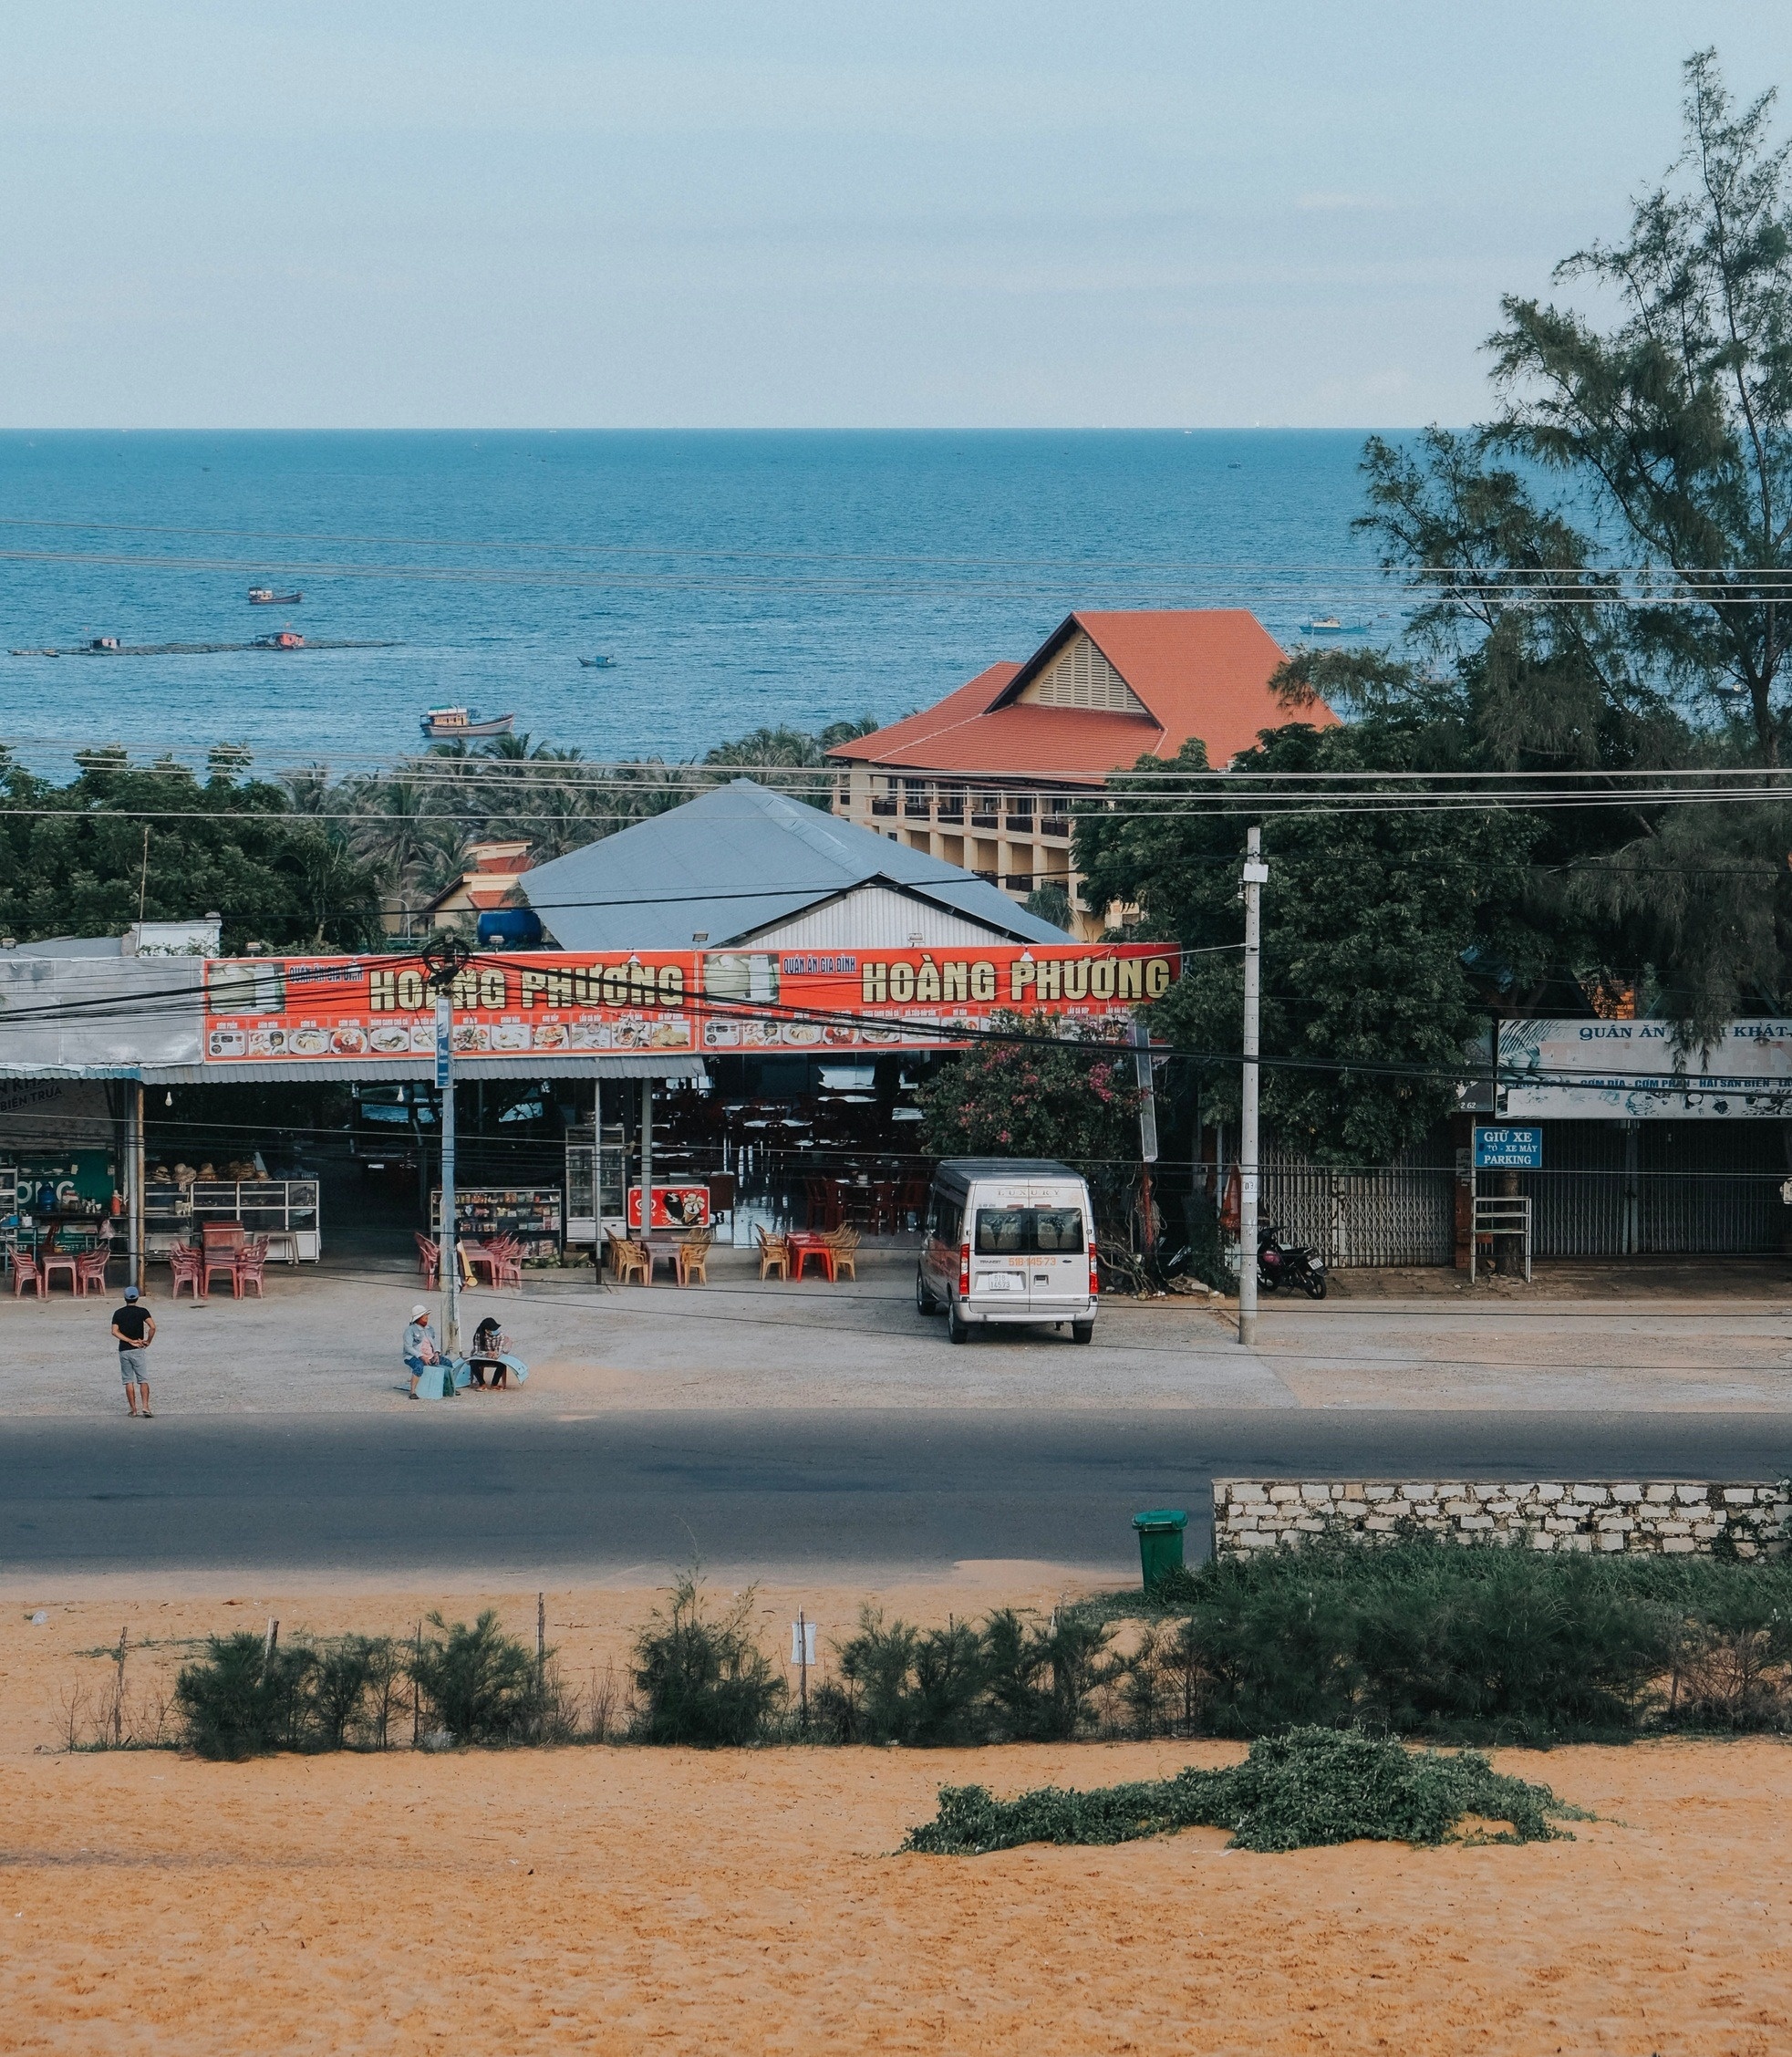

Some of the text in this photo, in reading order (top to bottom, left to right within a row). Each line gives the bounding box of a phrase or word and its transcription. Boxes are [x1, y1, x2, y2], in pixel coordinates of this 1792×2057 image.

[783, 954, 856, 973] QUÁN ĂN GIA ĐÌNH
[862, 954, 1170, 1003] HOÀNG PHƯƠNG
[369, 963, 683, 1012] HONG PHƯƠNG
[1579, 1024, 1632, 1041] QUÁN
[1639, 1024, 1665, 1038] ĂN
[1733, 1023, 1788, 1038] KHÁT
[1634, 1078, 1659, 1087] CƠM
[1466, 1101, 1476, 1109] 62
[1484, 1129, 1533, 1143] GIỮ XE
[1519, 1143, 1538, 1153] MÁY
[1484, 1155, 1532, 1165] PARKING
